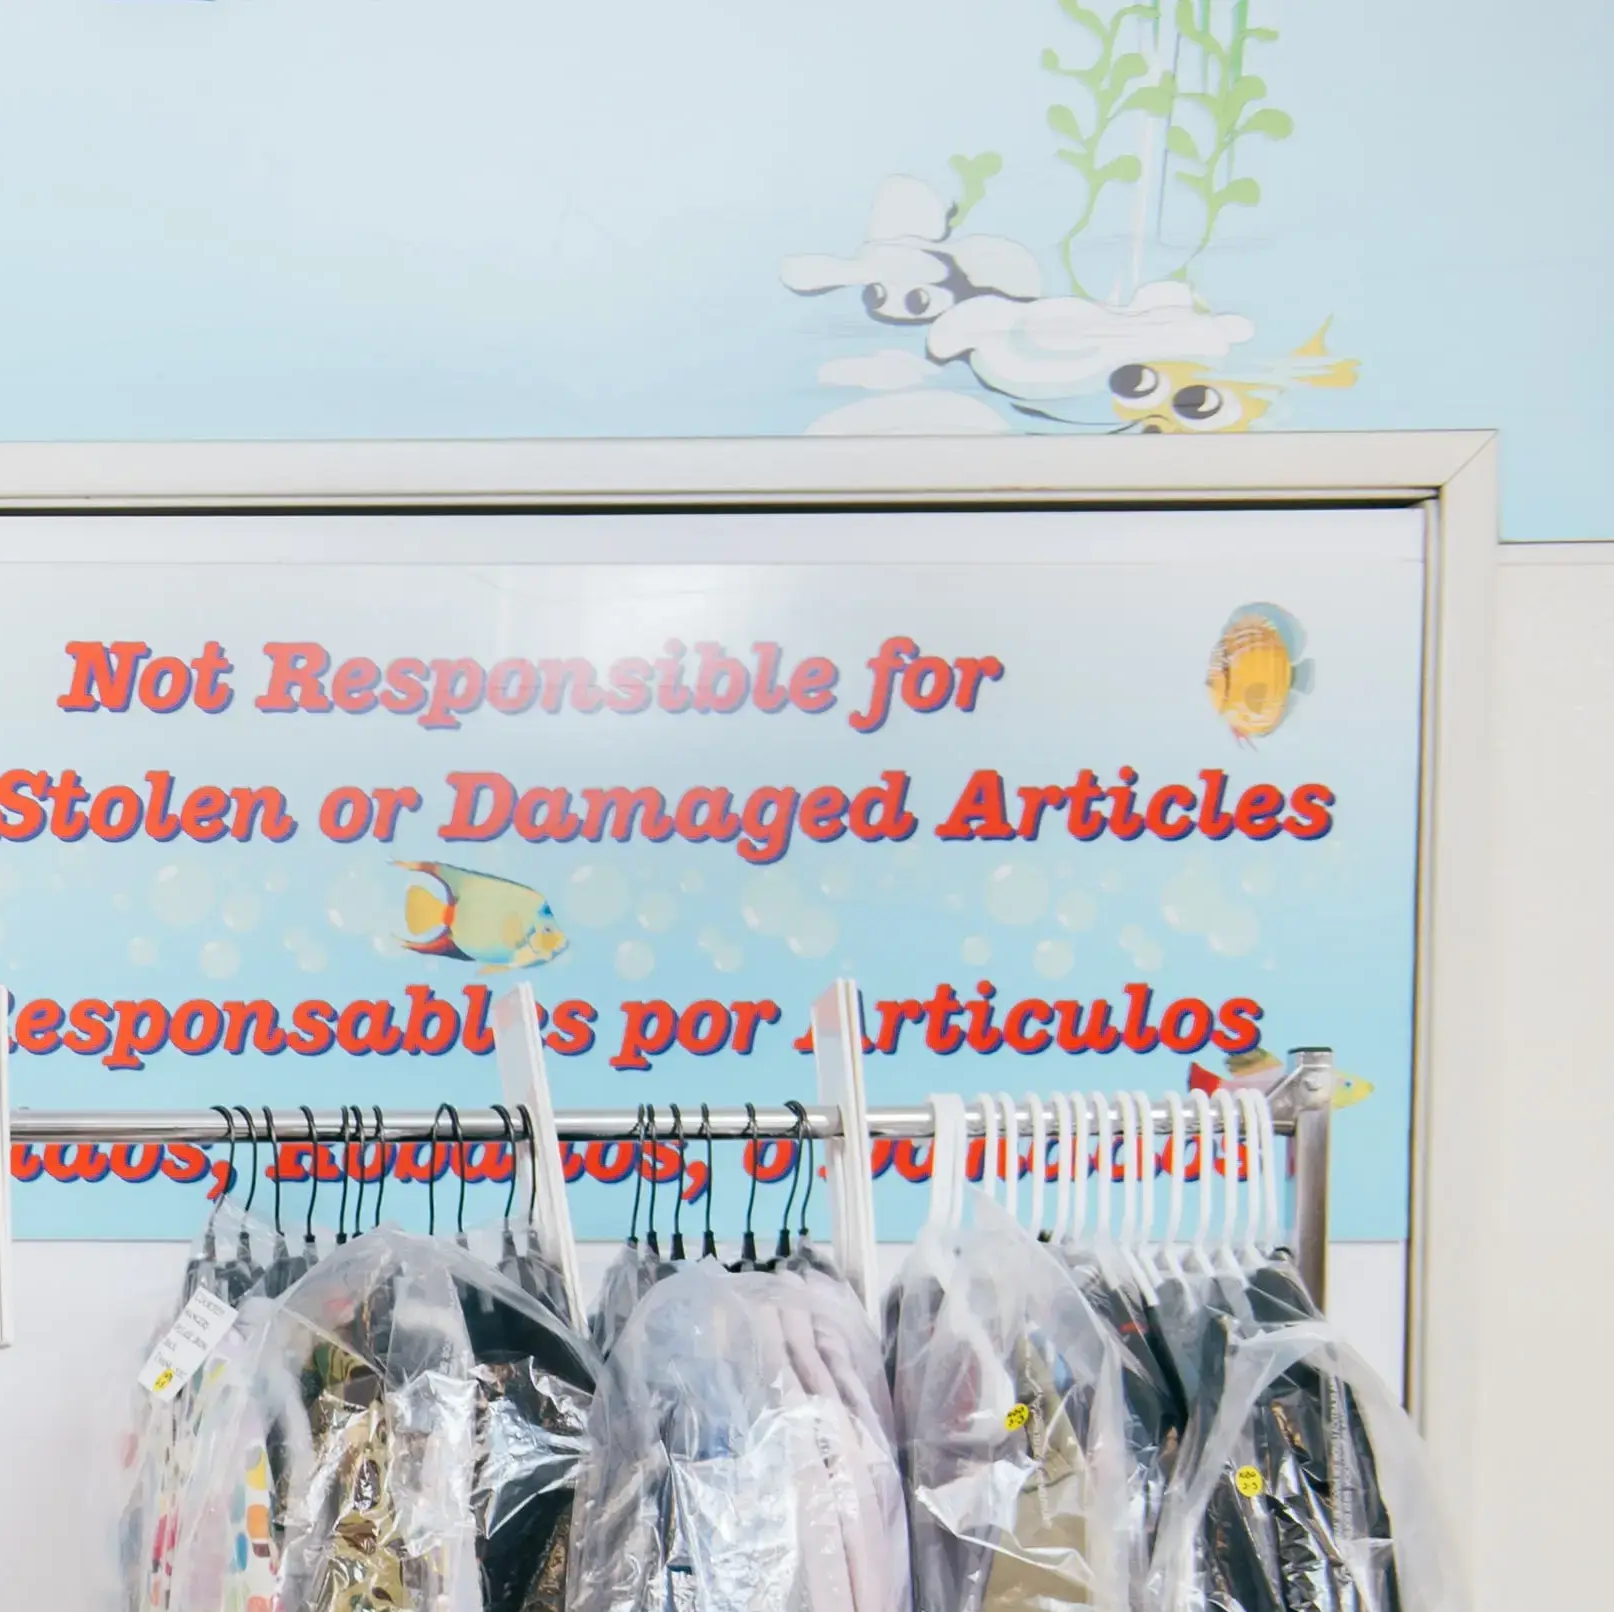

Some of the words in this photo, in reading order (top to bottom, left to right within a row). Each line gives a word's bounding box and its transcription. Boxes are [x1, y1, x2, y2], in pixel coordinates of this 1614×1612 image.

[58, 639, 235, 715] Not
[254, 637, 839, 730] Responsible
[848, 636, 1005, 733] for
[318, 783, 421, 844] or
[439, 769, 918, 863] Damaged
[936, 765, 1336, 842] Articles
[609, 999, 782, 1070] por
[793, 981, 1264, 1056] rticulos
